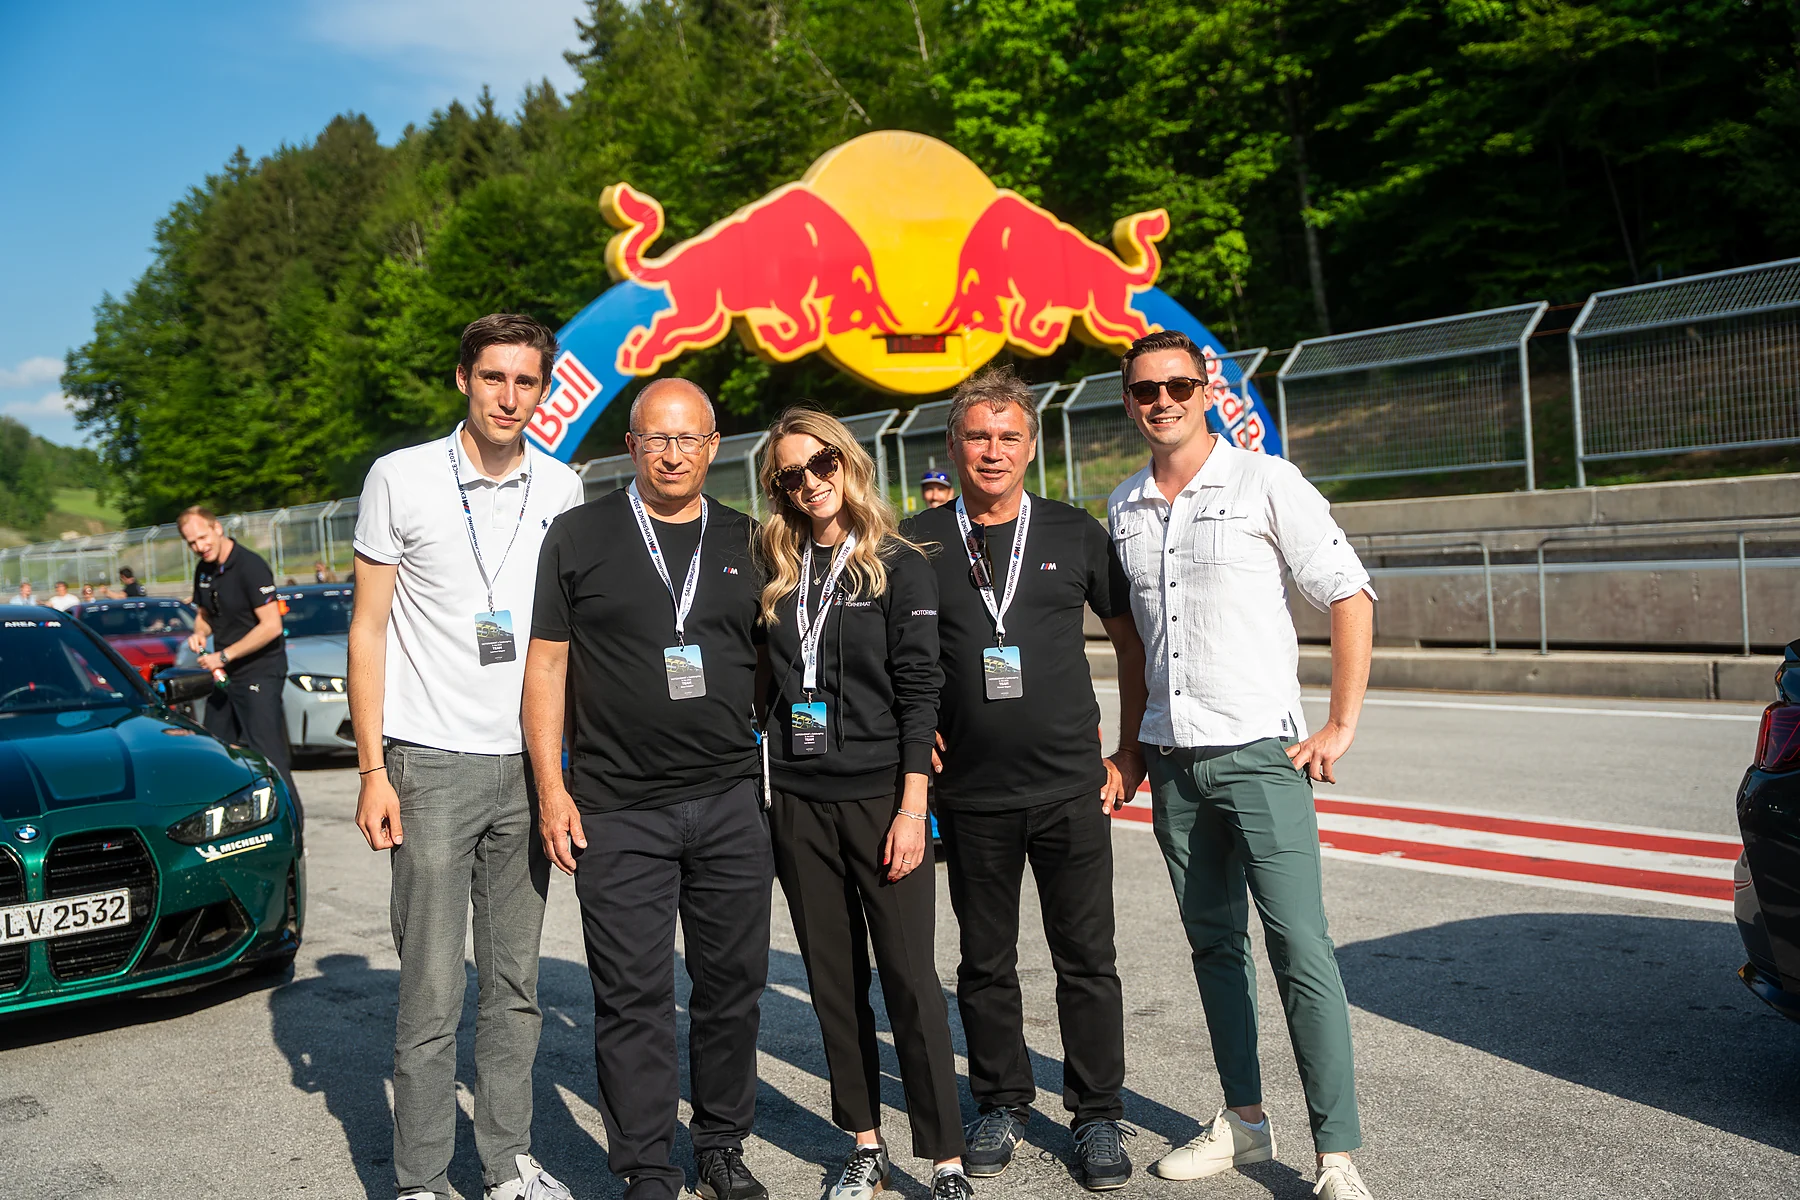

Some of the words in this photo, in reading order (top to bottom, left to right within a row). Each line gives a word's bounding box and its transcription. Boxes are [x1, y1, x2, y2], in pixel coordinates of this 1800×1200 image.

[527, 358, 596, 446] Bull
[1238, 418, 1260, 451] B
[637, 509, 652, 540] EXPERIENCE
[1005, 560, 1017, 600] SALZBURGRING
[1015, 516, 1026, 546] EXPERIENCE
[800, 609, 808, 652] SALZURGRING
[809, 607, 825, 650] SALZBURGRING
[220, 833, 274, 853] MICHELIN
[0, 908, 44, 938] LV
[53, 895, 126, 931] 2532
